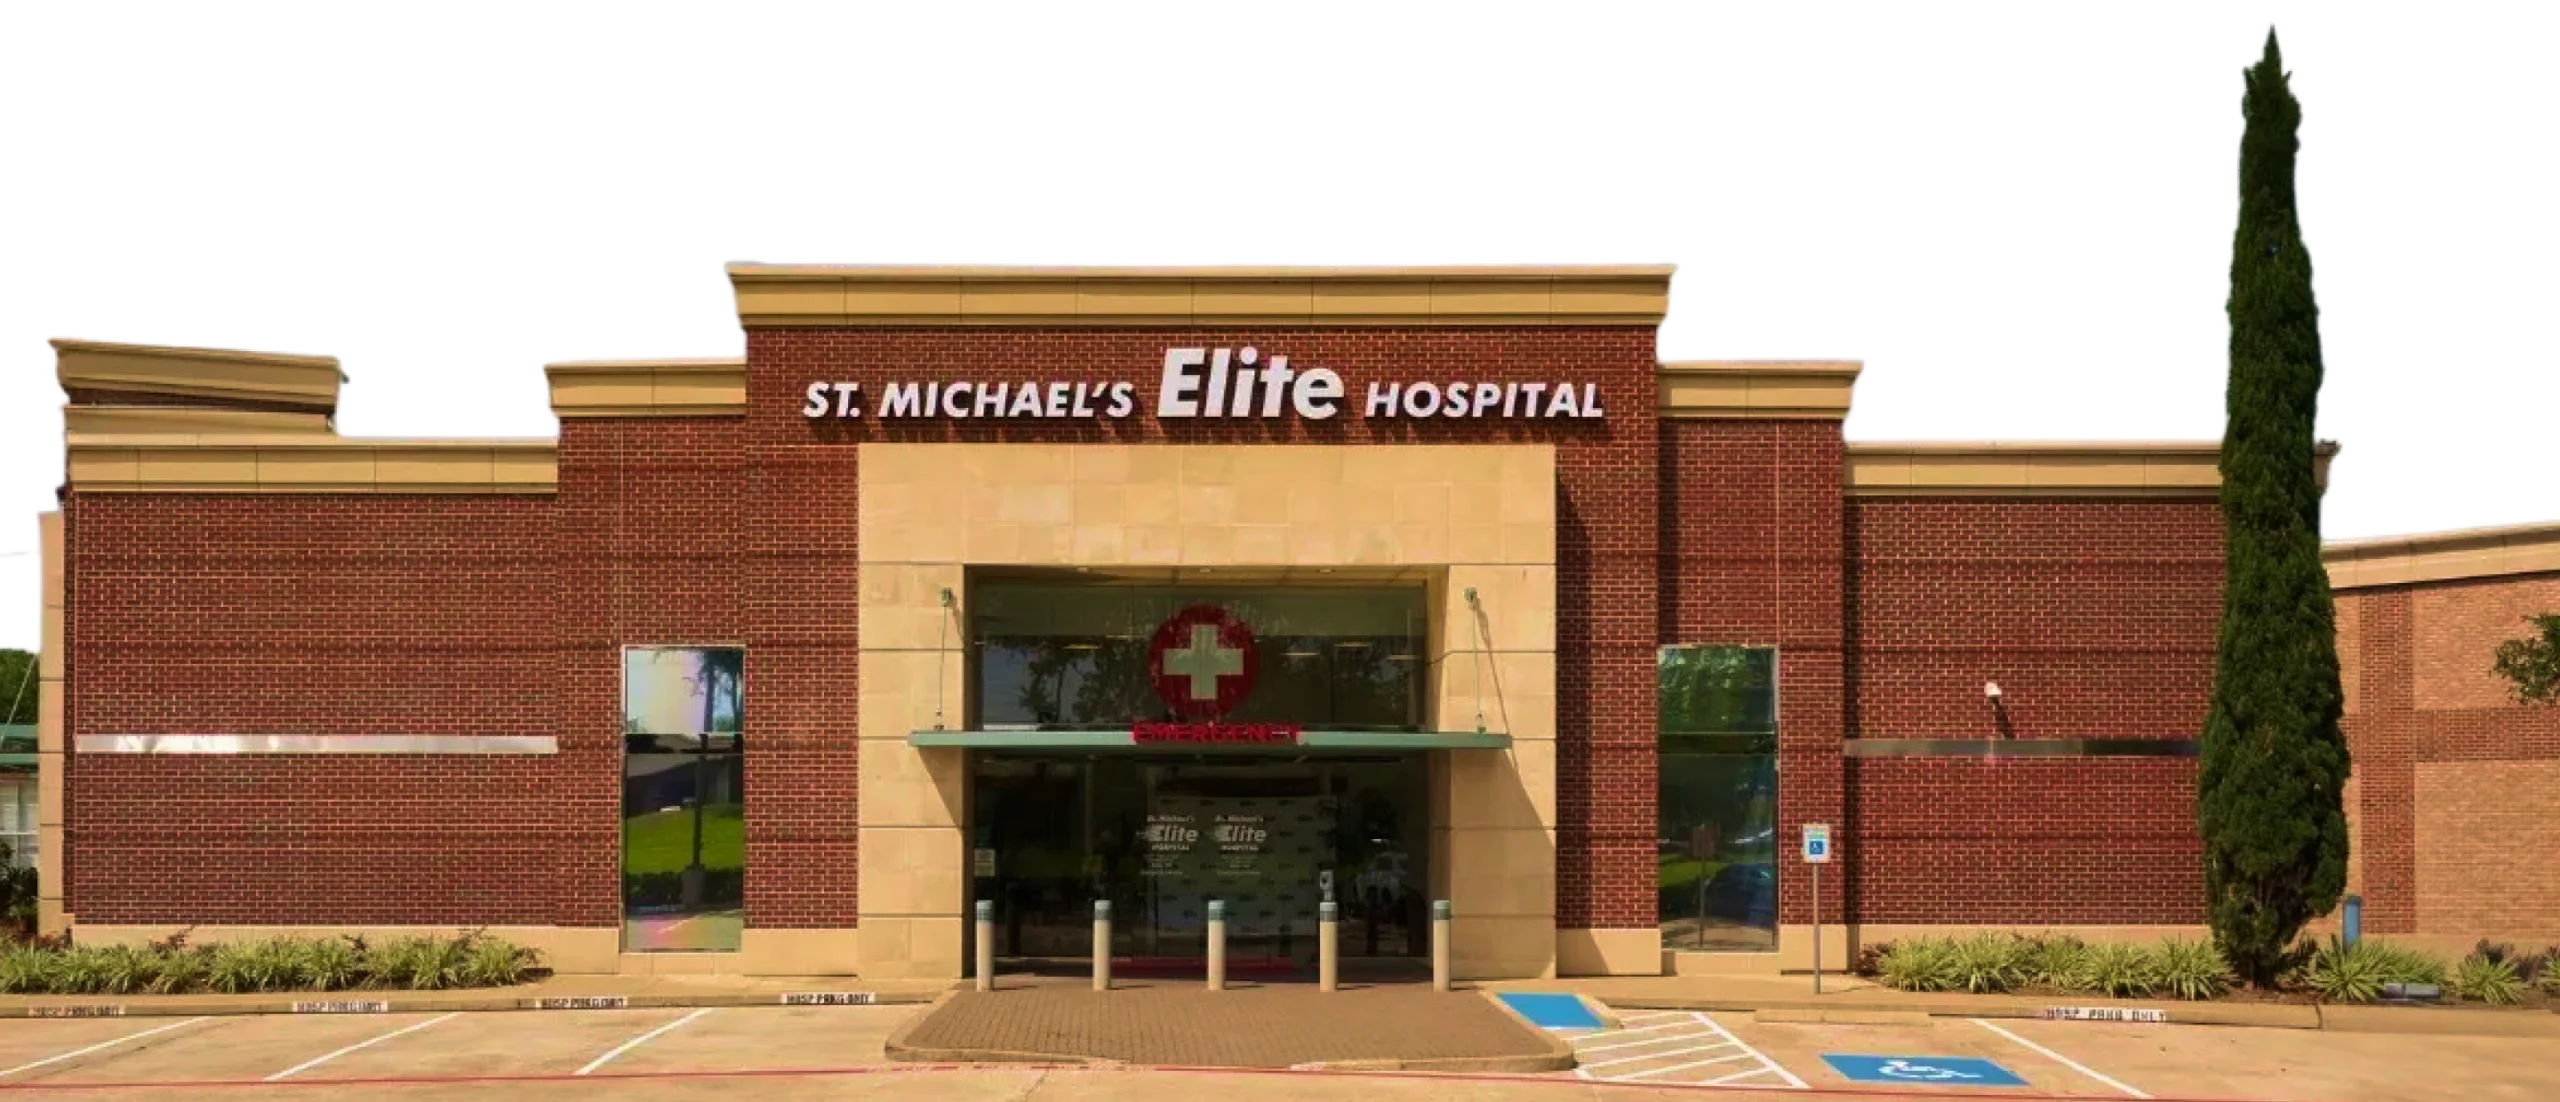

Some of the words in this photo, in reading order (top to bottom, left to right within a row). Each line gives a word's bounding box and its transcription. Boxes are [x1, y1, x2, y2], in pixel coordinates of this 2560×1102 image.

[803, 382, 861, 418] ST.
[1157, 346, 1344, 420] Elite
[1365, 381, 1603, 418] HOSPITAL
[1133, 723, 1302, 742] EMERGENCY
[1146, 824, 1198, 842] Elite
[1215, 824, 1266, 842] Elite
